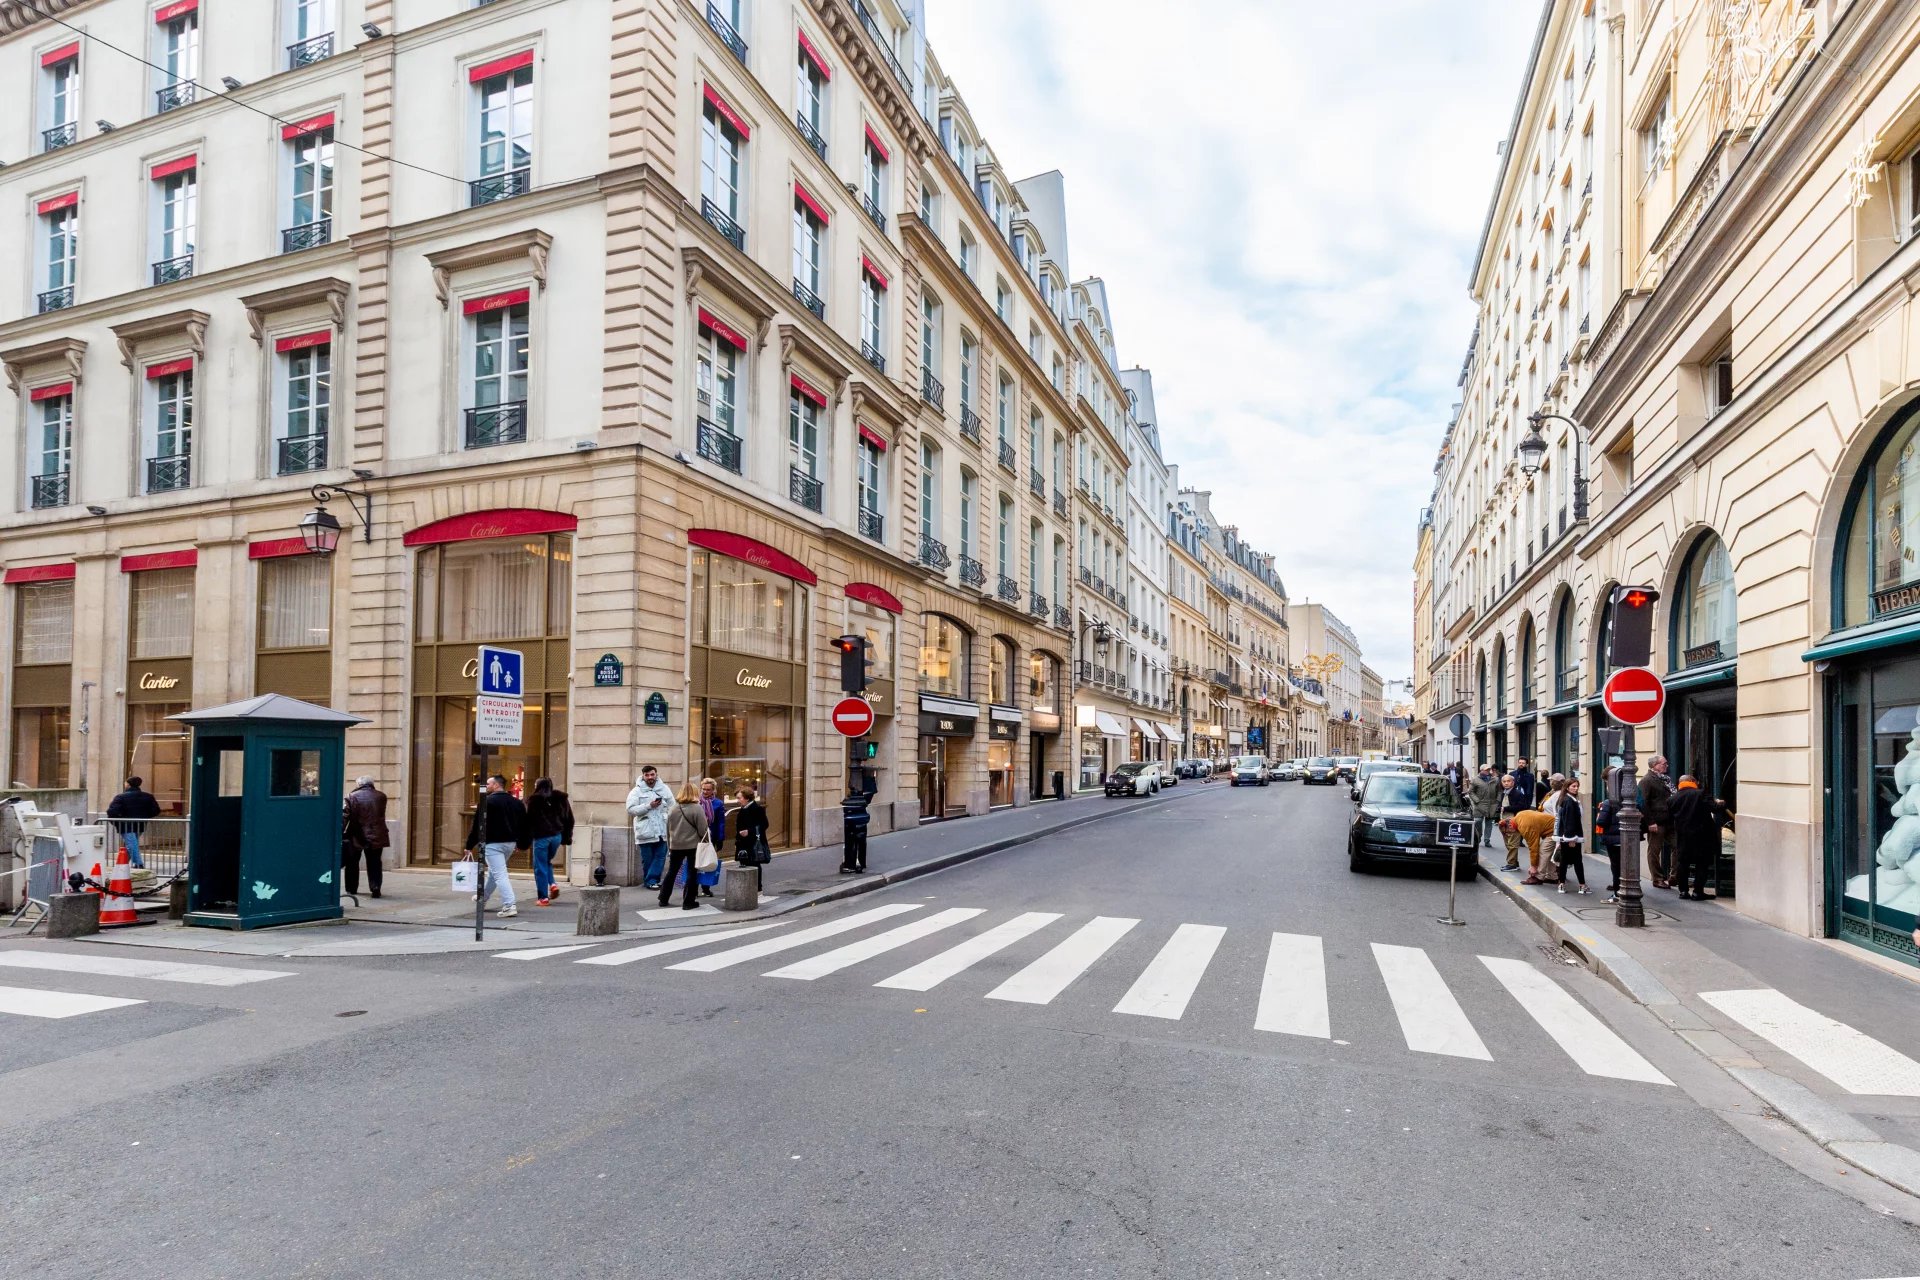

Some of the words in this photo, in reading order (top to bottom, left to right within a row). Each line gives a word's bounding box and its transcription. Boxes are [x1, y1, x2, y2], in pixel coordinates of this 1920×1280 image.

[717, 100, 737, 124] Cartier
[483, 299, 508, 310] Cartier
[713, 321, 732, 340] Cartier
[292, 338, 313, 349] Cartier
[470, 523, 507, 537] Cartier
[746, 549, 771, 566] Cartier
[140, 672, 179, 689] Cartier
[736, 668, 772, 688] Cartier
[482, 700, 522, 709] CIRCULATION
[483, 708, 520, 717] INTERDITE
